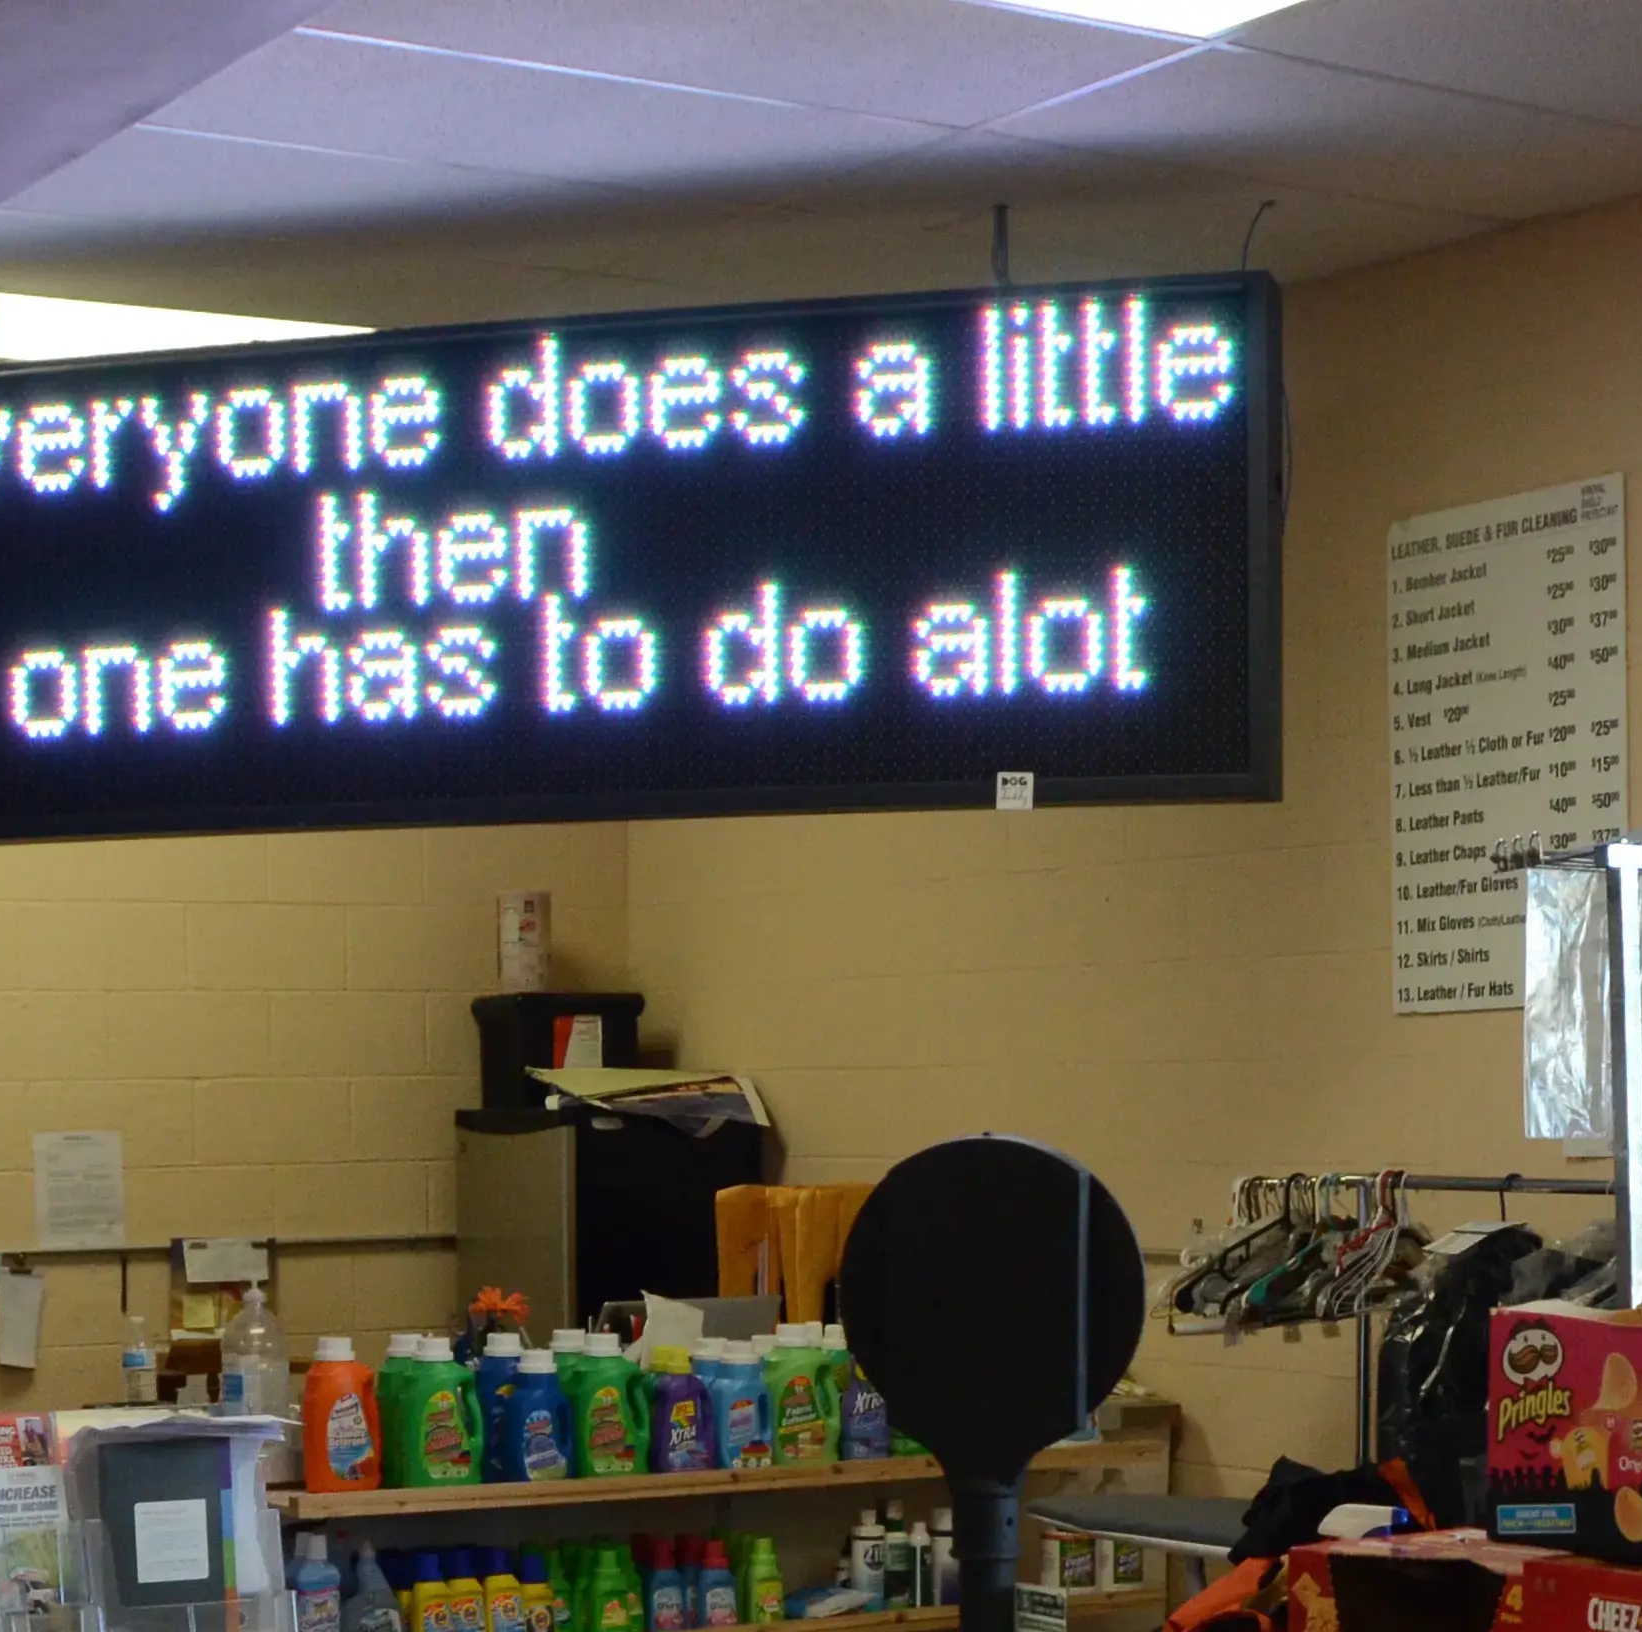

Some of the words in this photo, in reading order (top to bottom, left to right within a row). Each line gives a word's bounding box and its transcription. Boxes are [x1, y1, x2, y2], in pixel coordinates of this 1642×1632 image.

[485, 331, 806, 460] does
[854, 340, 932, 439] a
[977, 292, 1237, 434] little
[318, 489, 593, 612] then
[1391, 536, 1442, 561] LEATHER,
[1446, 527, 1480, 550] SUEDE
[1496, 520, 1518, 540] FUR
[1522, 507, 1577, 534] CLEANING
[9, 641, 229, 738] one
[268, 607, 499, 729] has
[542, 591, 657, 716] to
[701, 578, 865, 708] do
[912, 562, 1149, 700] alot
[1407, 712, 1431, 729] Vest
[1409, 813, 1449, 833] Leather
[1454, 809, 1485, 826] Pants
[1410, 847, 1450, 865] Leather
[1453, 844, 1487, 862] Chaps
[1417, 951, 1448, 968] Skirts
[1457, 948, 1490, 964] Shirts
[1417, 983, 1457, 1002] Leather
[1467, 983, 1485, 998] Fur
[1489, 980, 1514, 995] Hats
[1497, 1381, 1571, 1440] Pringles
